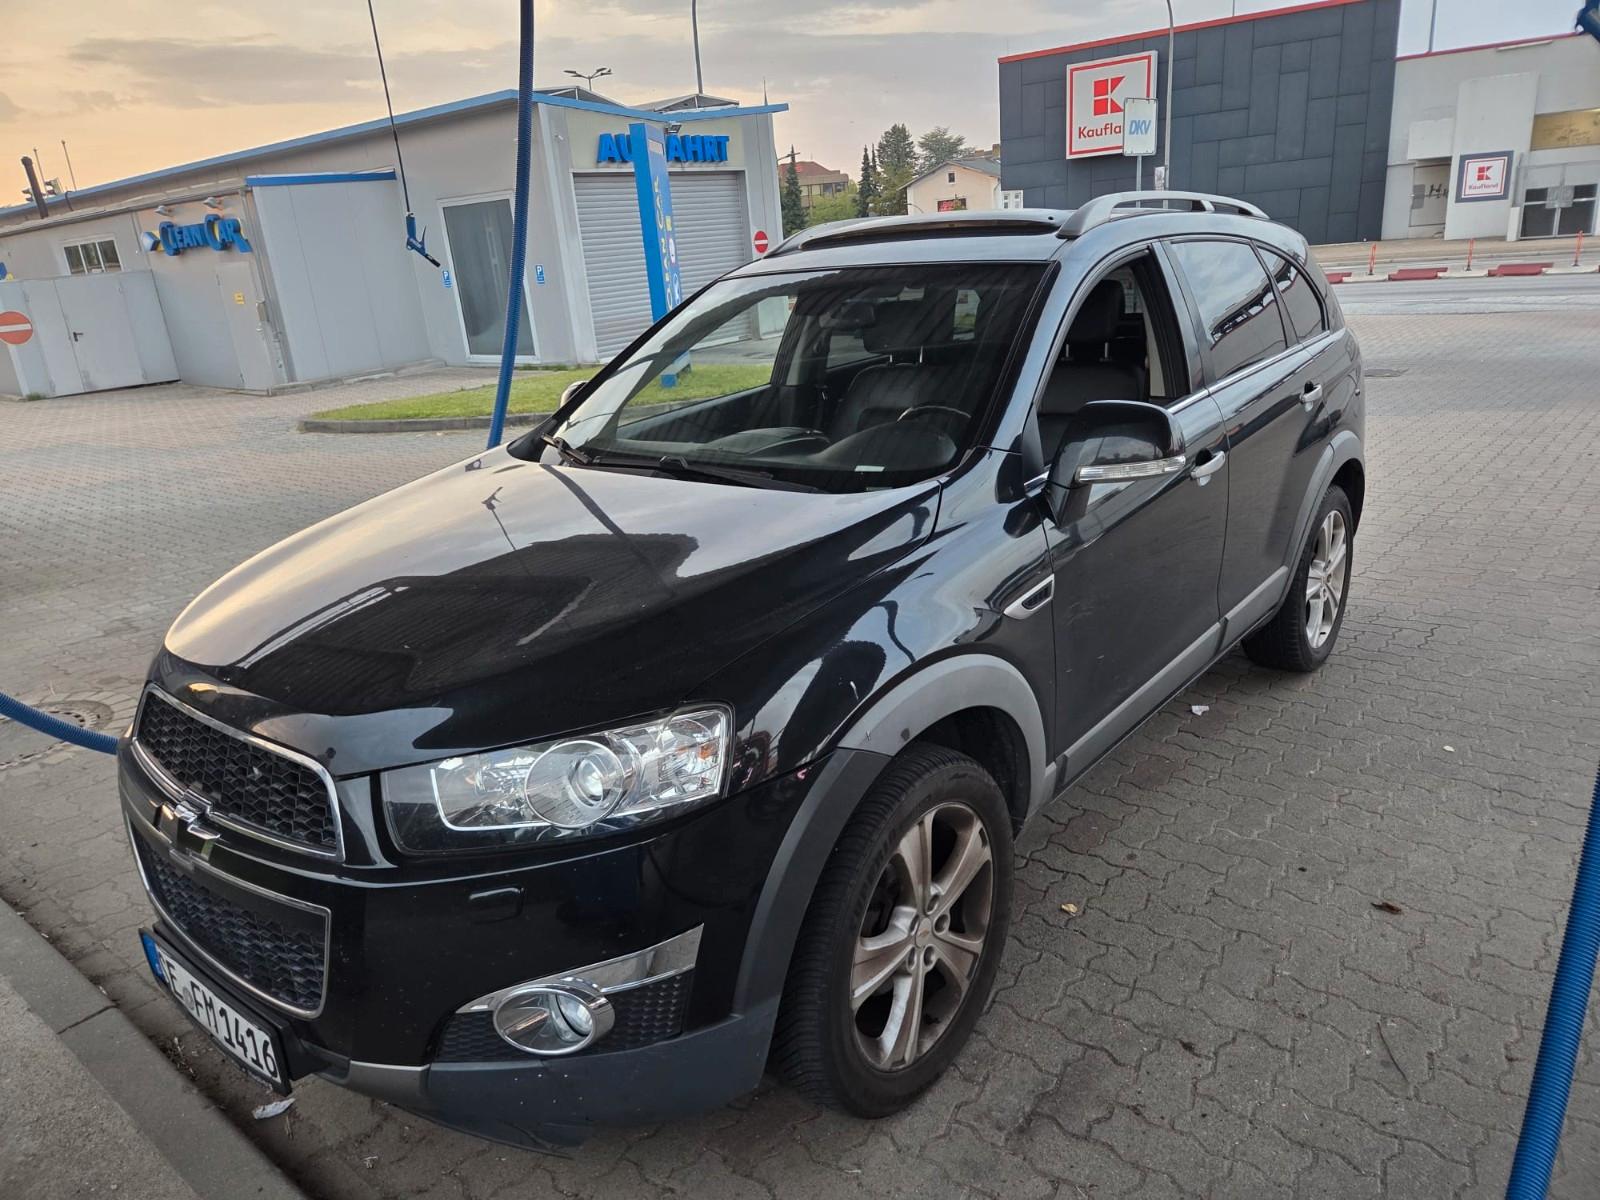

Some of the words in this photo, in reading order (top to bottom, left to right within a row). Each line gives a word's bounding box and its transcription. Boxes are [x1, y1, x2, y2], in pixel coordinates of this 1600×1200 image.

[1078, 122, 1121, 139] Kaufla
[1128, 118, 1152, 136] DKV
[597, 132, 730, 163] AUAHRT
[159, 221, 207, 256] CLEAN
[205, 214, 253, 253] CAR
